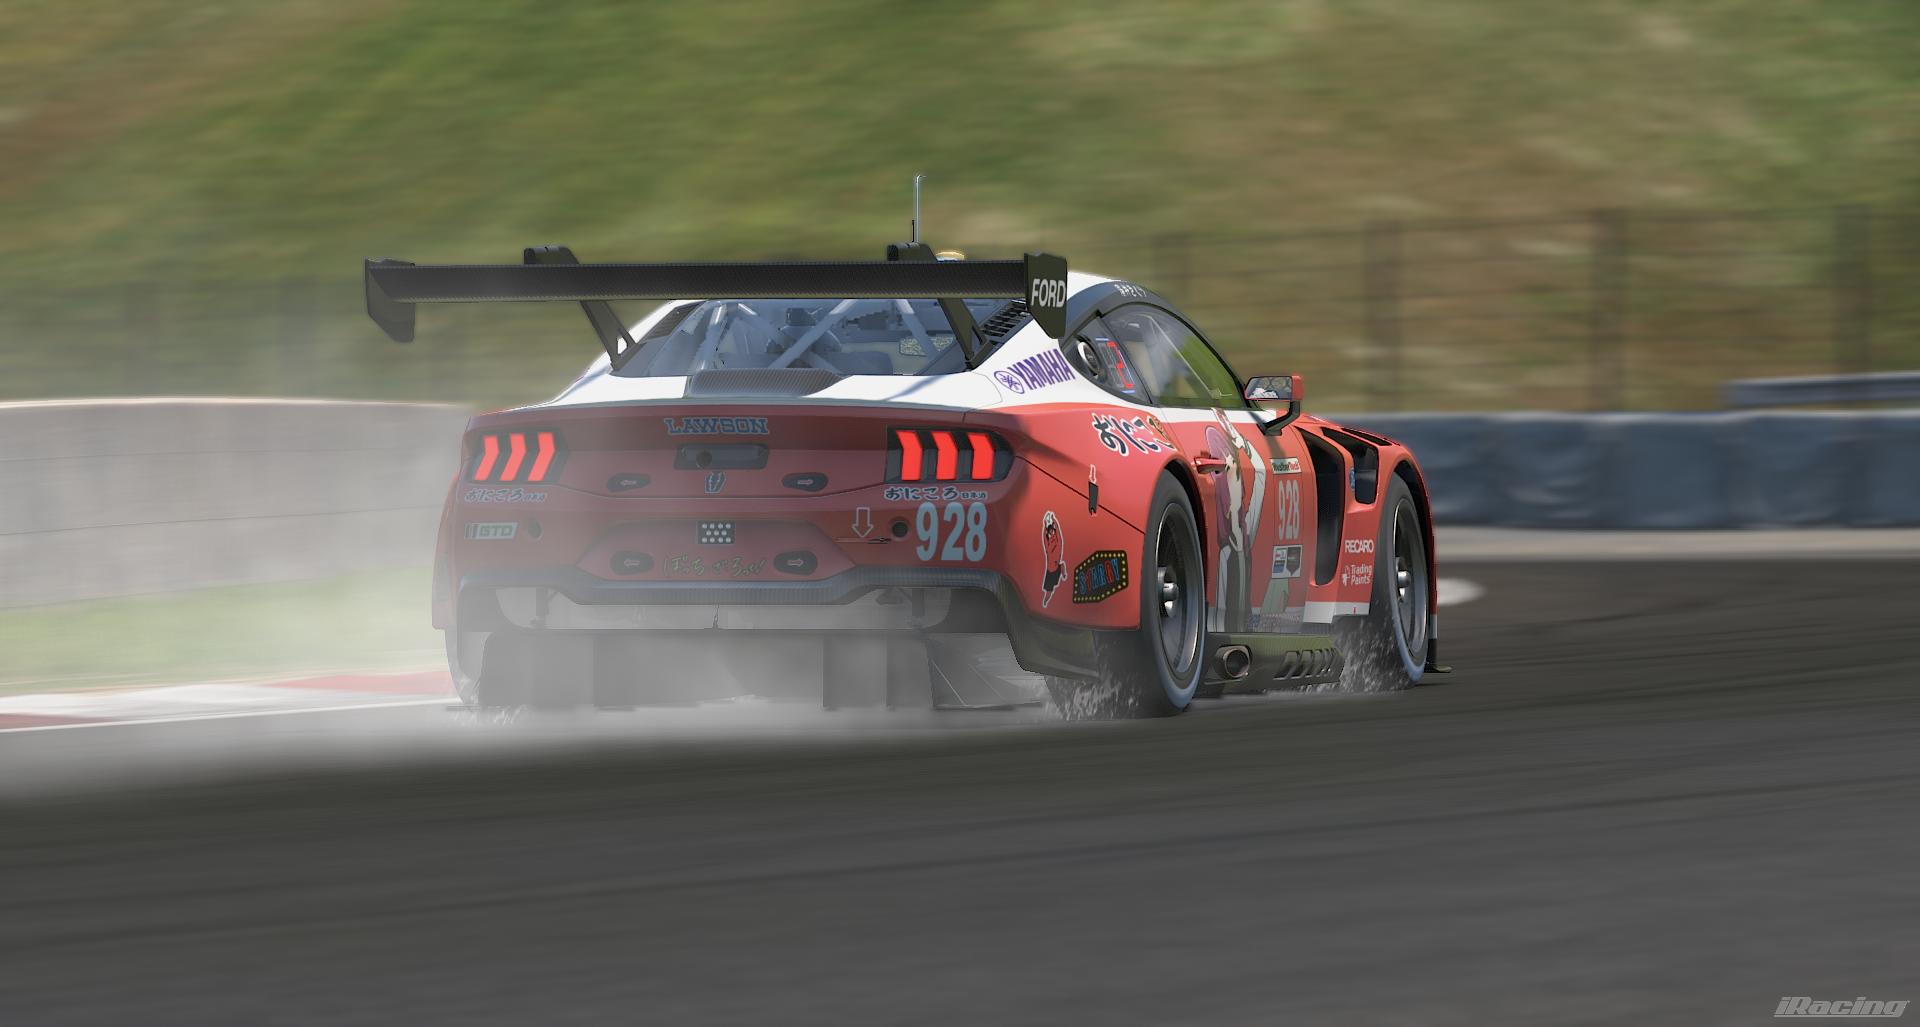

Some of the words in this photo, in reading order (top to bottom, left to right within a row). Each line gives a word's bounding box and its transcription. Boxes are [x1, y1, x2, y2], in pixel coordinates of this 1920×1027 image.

[1031, 278, 1066, 308] FORD
[1007, 348, 1076, 390] YAMAHA
[664, 416, 769, 435] LAWSON
[1278, 480, 1300, 540] 928
[479, 524, 514, 537] GTD
[916, 501, 988, 562] 928
[1344, 539, 1374, 553] RECARO
[1351, 564, 1372, 575] Trading
[1351, 574, 1371, 585] Paints
